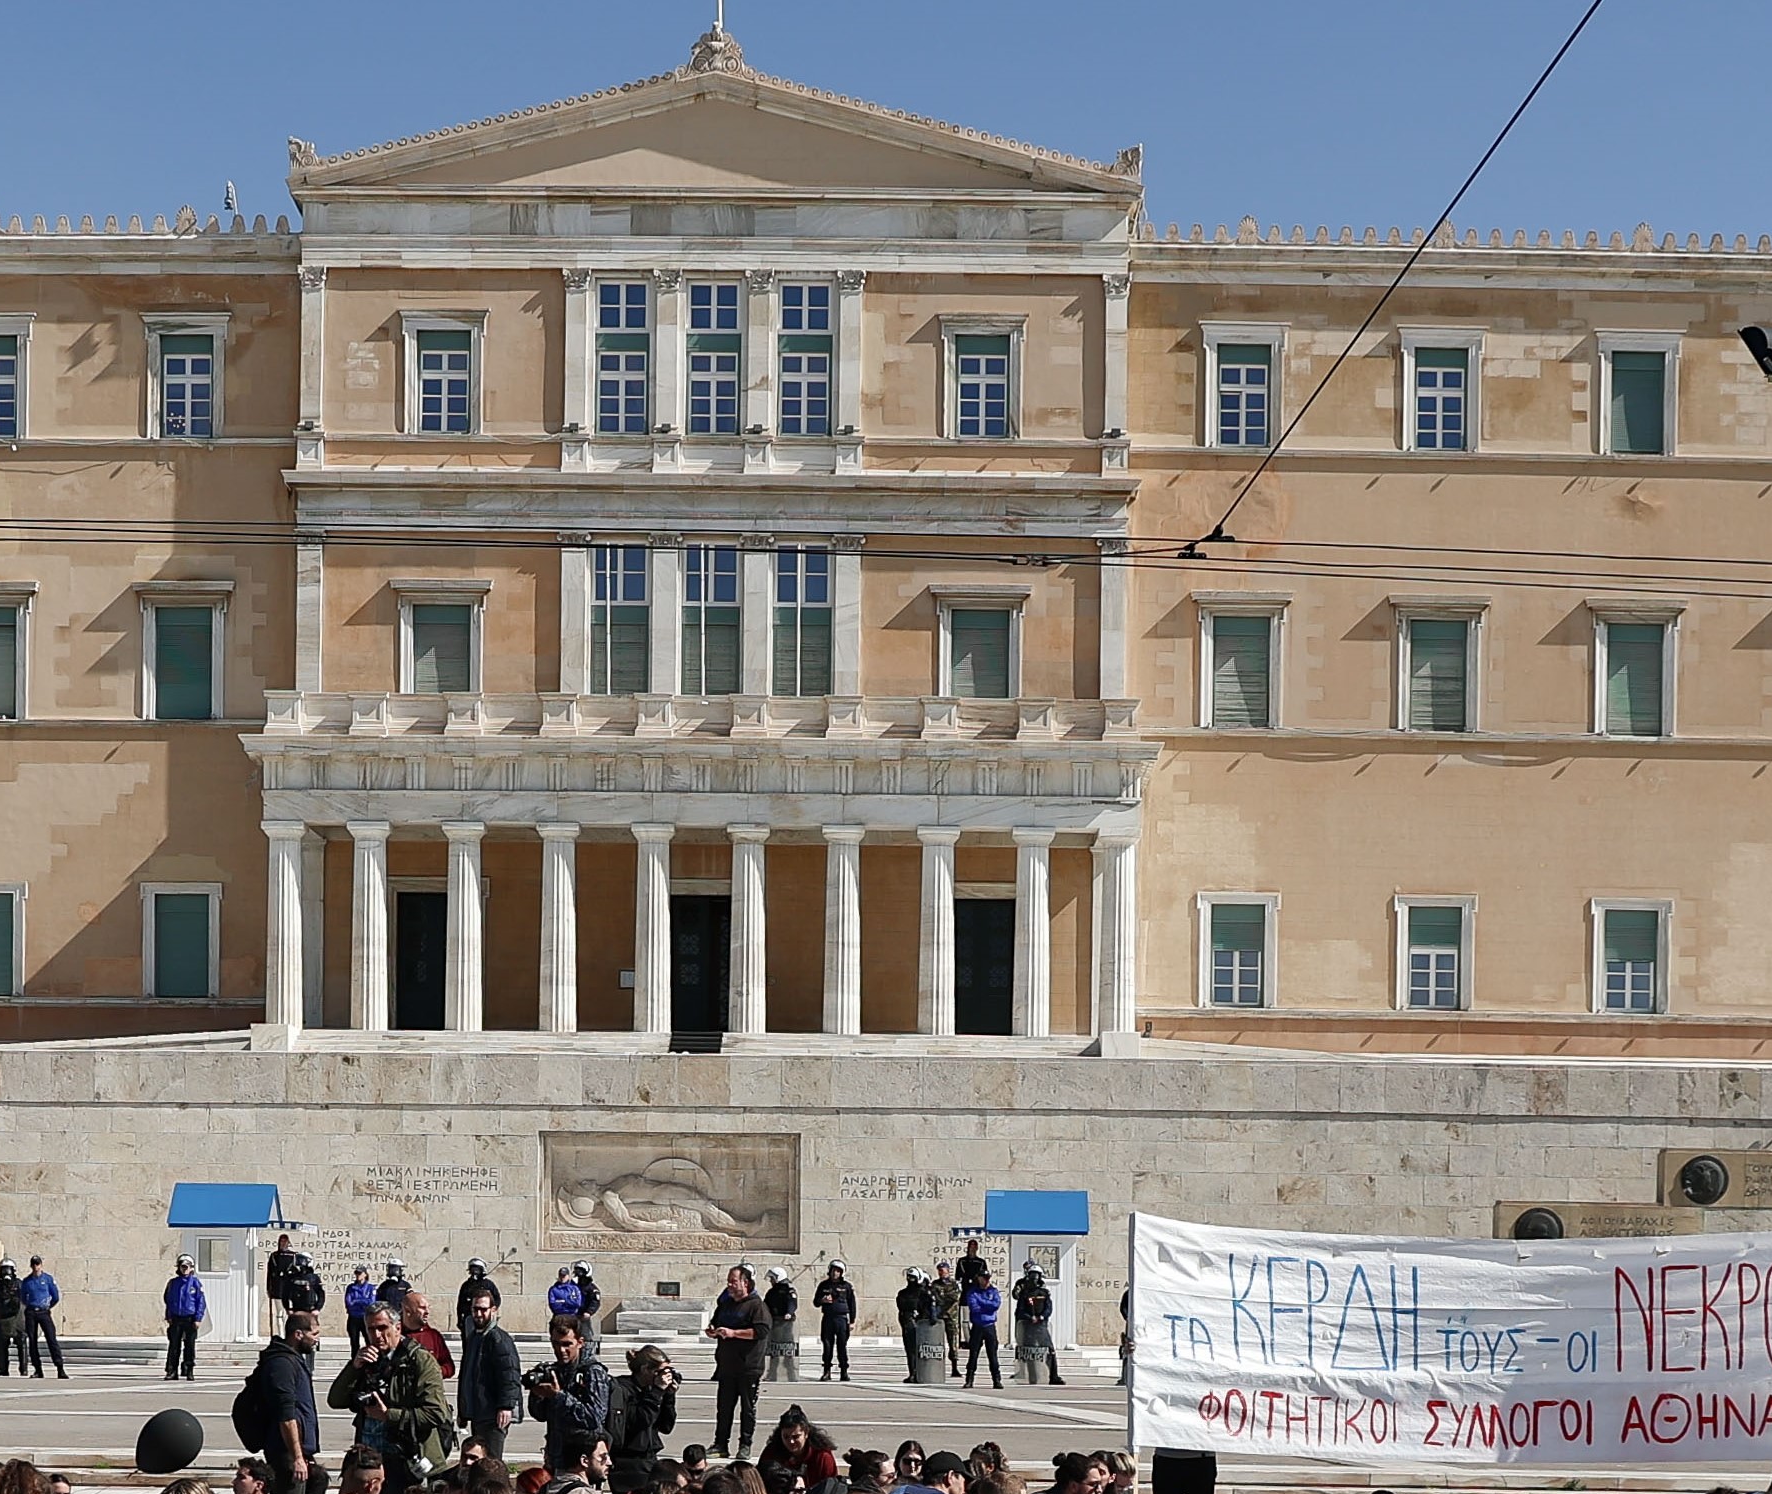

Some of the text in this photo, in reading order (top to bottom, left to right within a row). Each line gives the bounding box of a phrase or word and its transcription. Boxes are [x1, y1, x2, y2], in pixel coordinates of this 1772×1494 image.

[1163, 1314, 1214, 1362] ΤΑ
[1229, 1253, 1419, 1371] ΚΕΡΔΗ
[1567, 1331, 1597, 1373] ΟΙ
[1198, 1389, 1397, 1447] ΦΟΙΤΗΤΙΚΟΙ
[1424, 1399, 1593, 1450] ΣΥΛΛΟΓΟΙ
